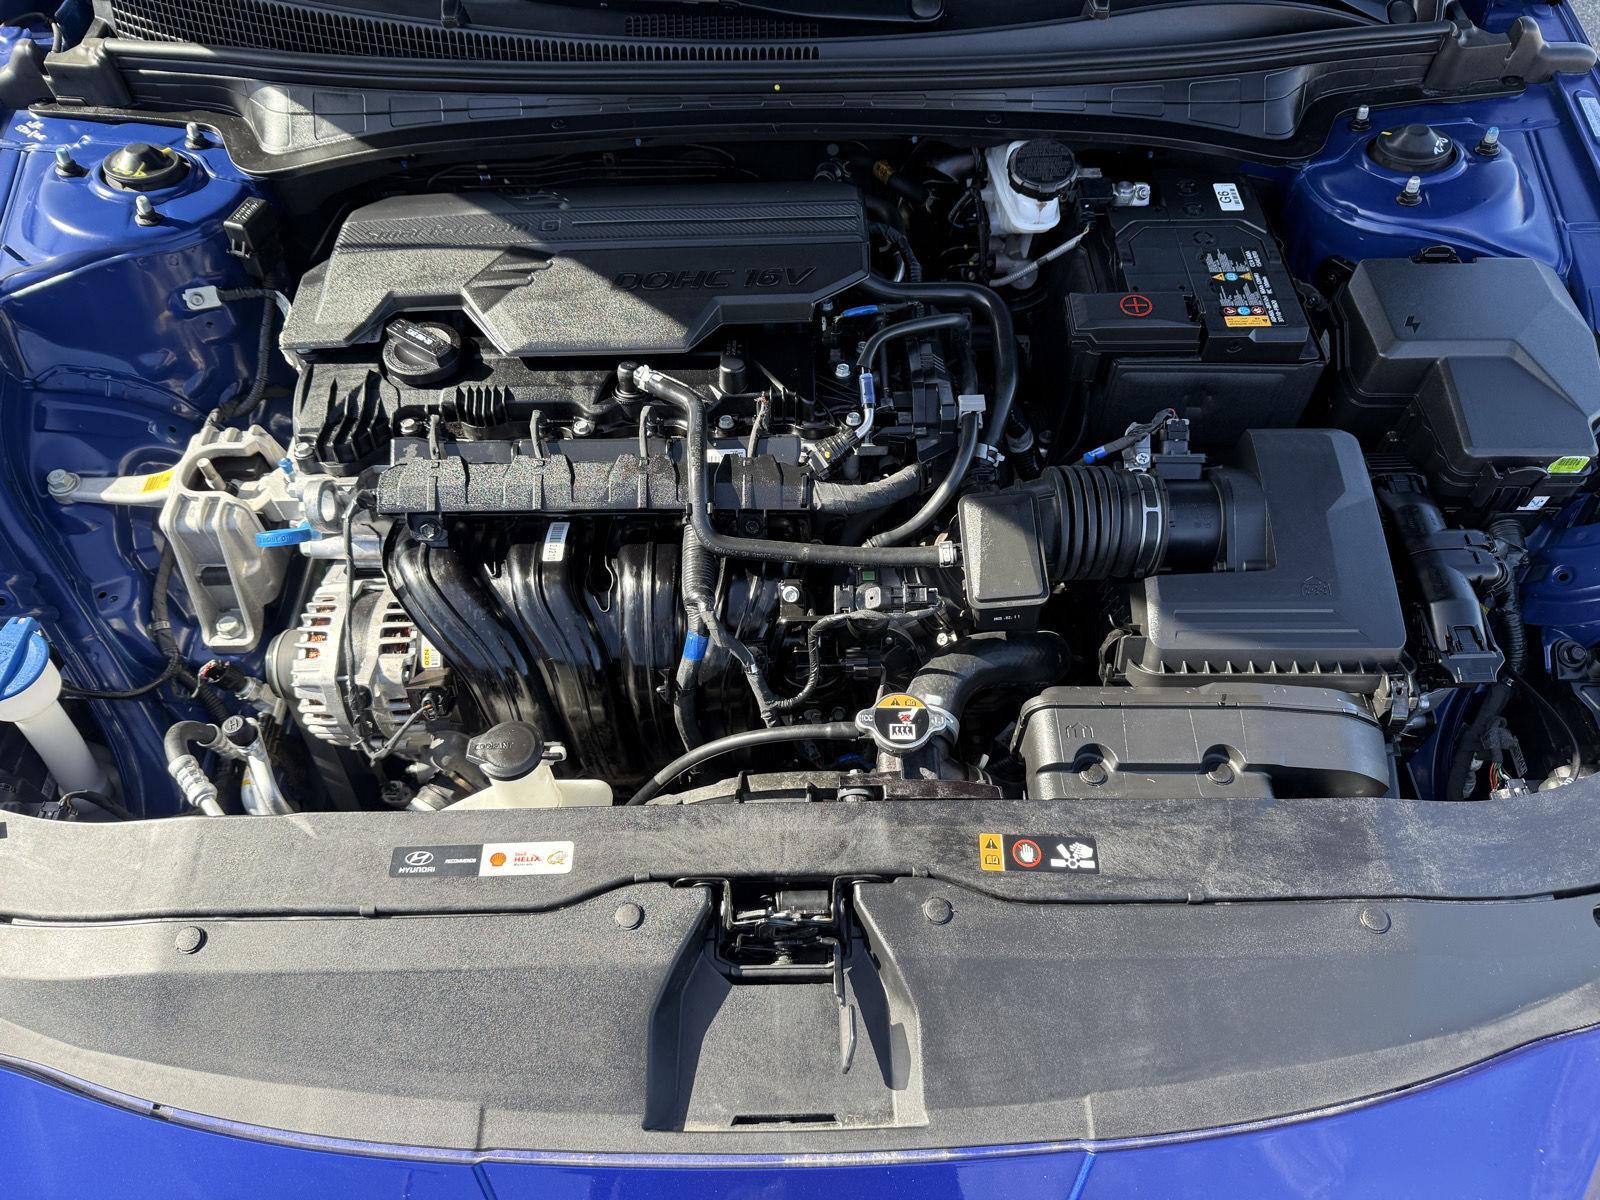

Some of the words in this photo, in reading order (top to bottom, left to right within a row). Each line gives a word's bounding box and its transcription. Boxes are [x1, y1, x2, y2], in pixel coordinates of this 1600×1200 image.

[1217, 190, 1232, 203] G6
[615, 268, 735, 290] DOHC
[743, 266, 817, 288] 16V
[514, 855, 543, 863] HELIX
[398, 866, 436, 874] HYUNDAI
